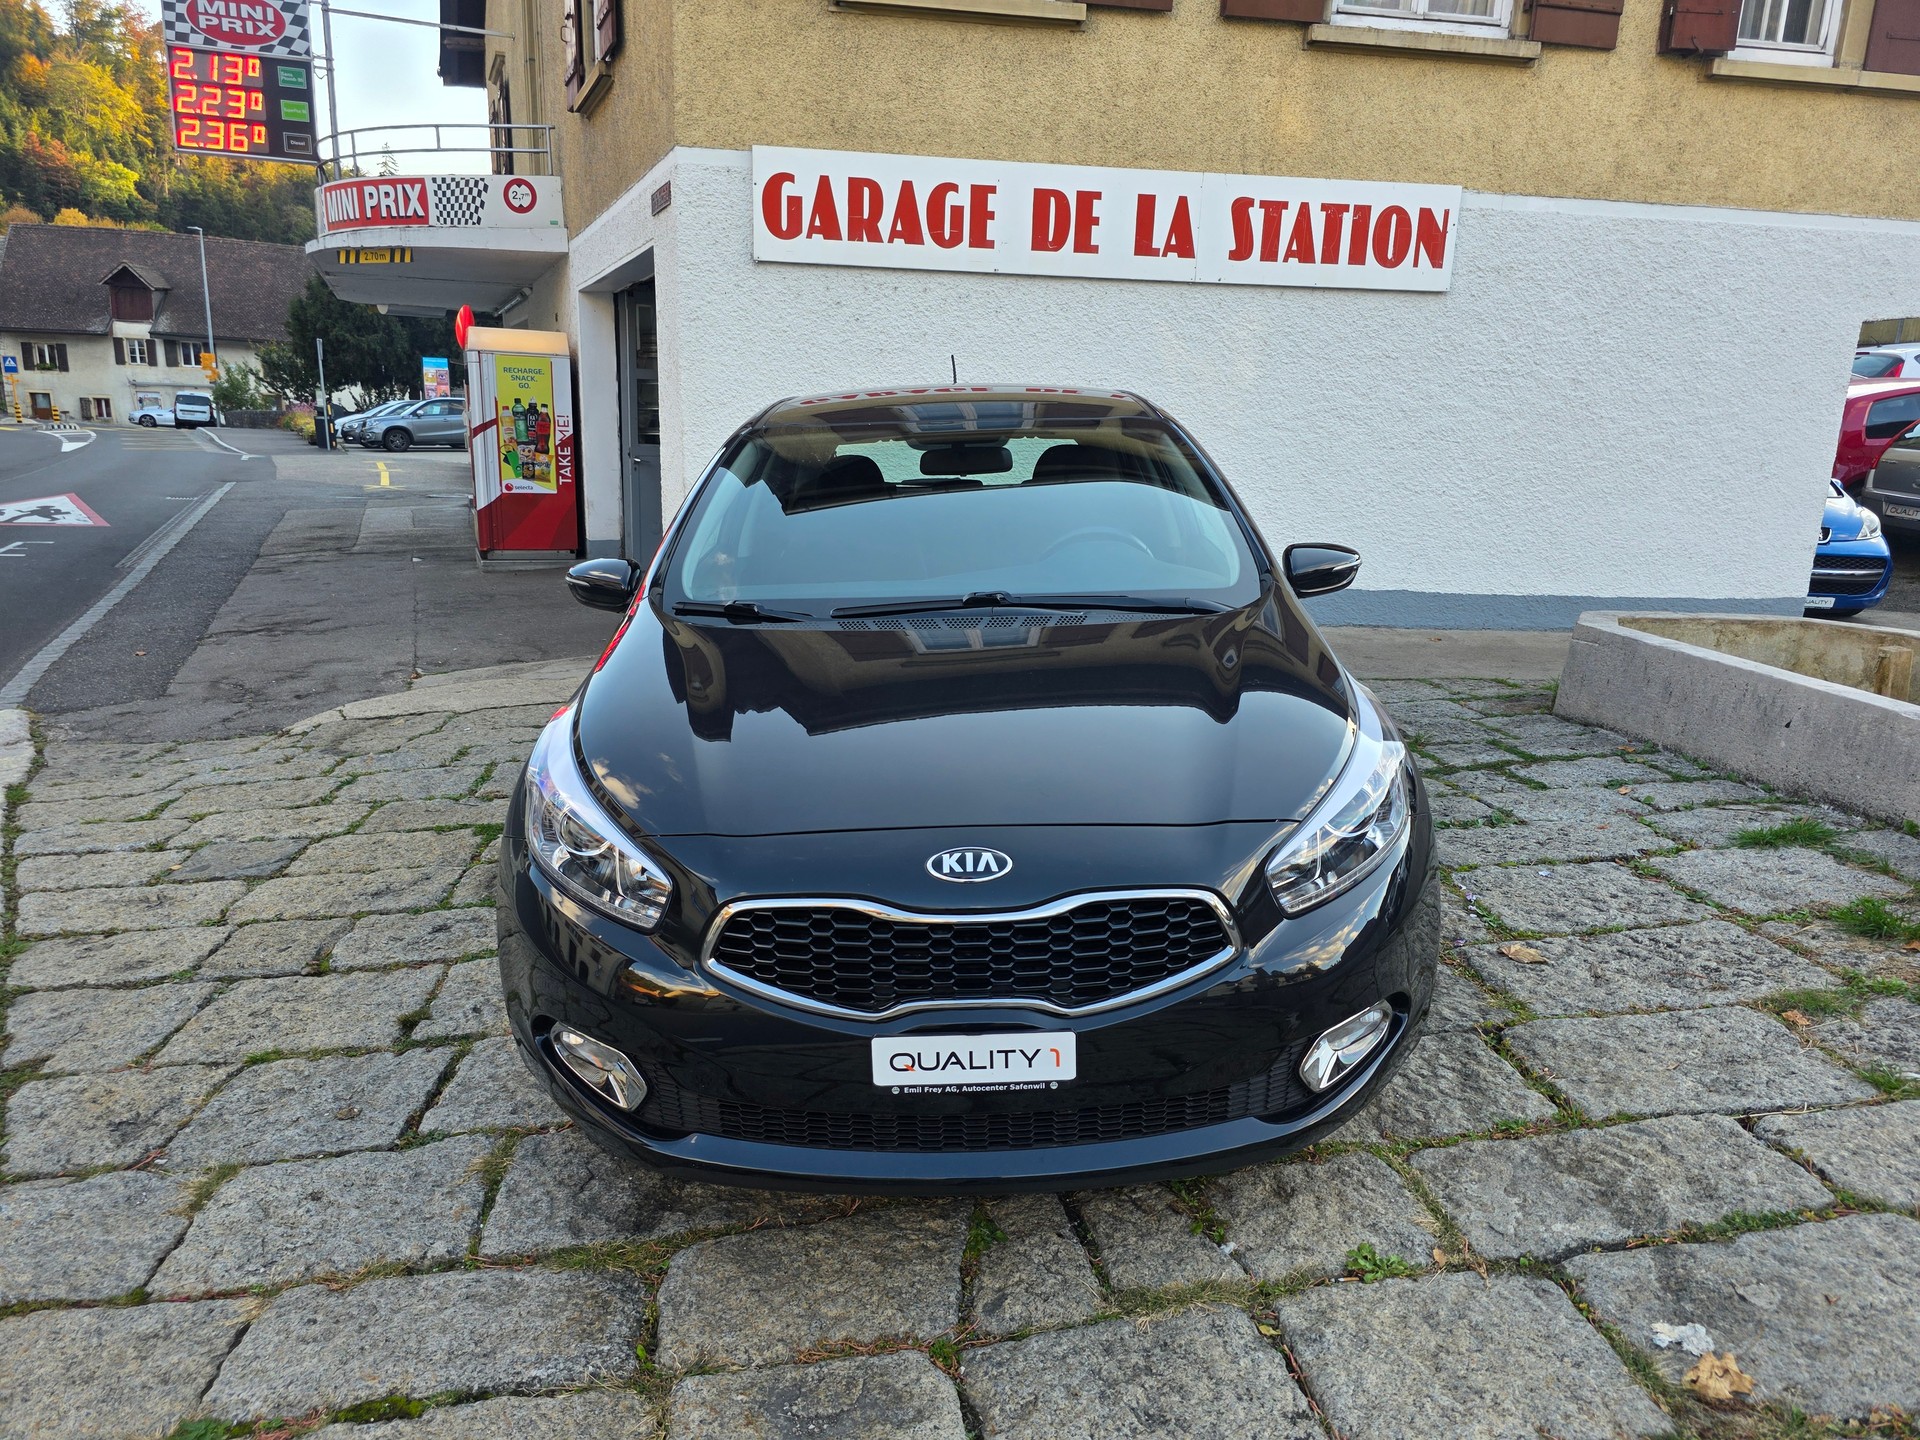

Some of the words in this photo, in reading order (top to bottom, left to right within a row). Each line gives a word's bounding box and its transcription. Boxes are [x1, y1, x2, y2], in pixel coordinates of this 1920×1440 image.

[197, 0, 275, 22] MINI
[198, 15, 278, 38] PRIX
[326, 187, 360, 223] MINI
[364, 183, 425, 219] PRIX
[761, 171, 997, 250] GARAGE
[1030, 187, 1103, 254] DE
[1133, 193, 1196, 259] LA
[1227, 195, 1450, 270] STATION
[503, 366, 545, 375] RECHARGE.
[556, 414, 570, 447] ME!
[558, 446, 572, 486] TAKE
[941, 852, 999, 874] KIA
[889, 1048, 1041, 1072] QUALITY
[904, 1086, 922, 1094] Emil
[924, 1086, 943, 1095] Frey
[944, 1085, 960, 1094] AG,
[962, 1084, 1008, 1093] Autocenter
[1009, 1082, 1046, 1091] Safenwil
